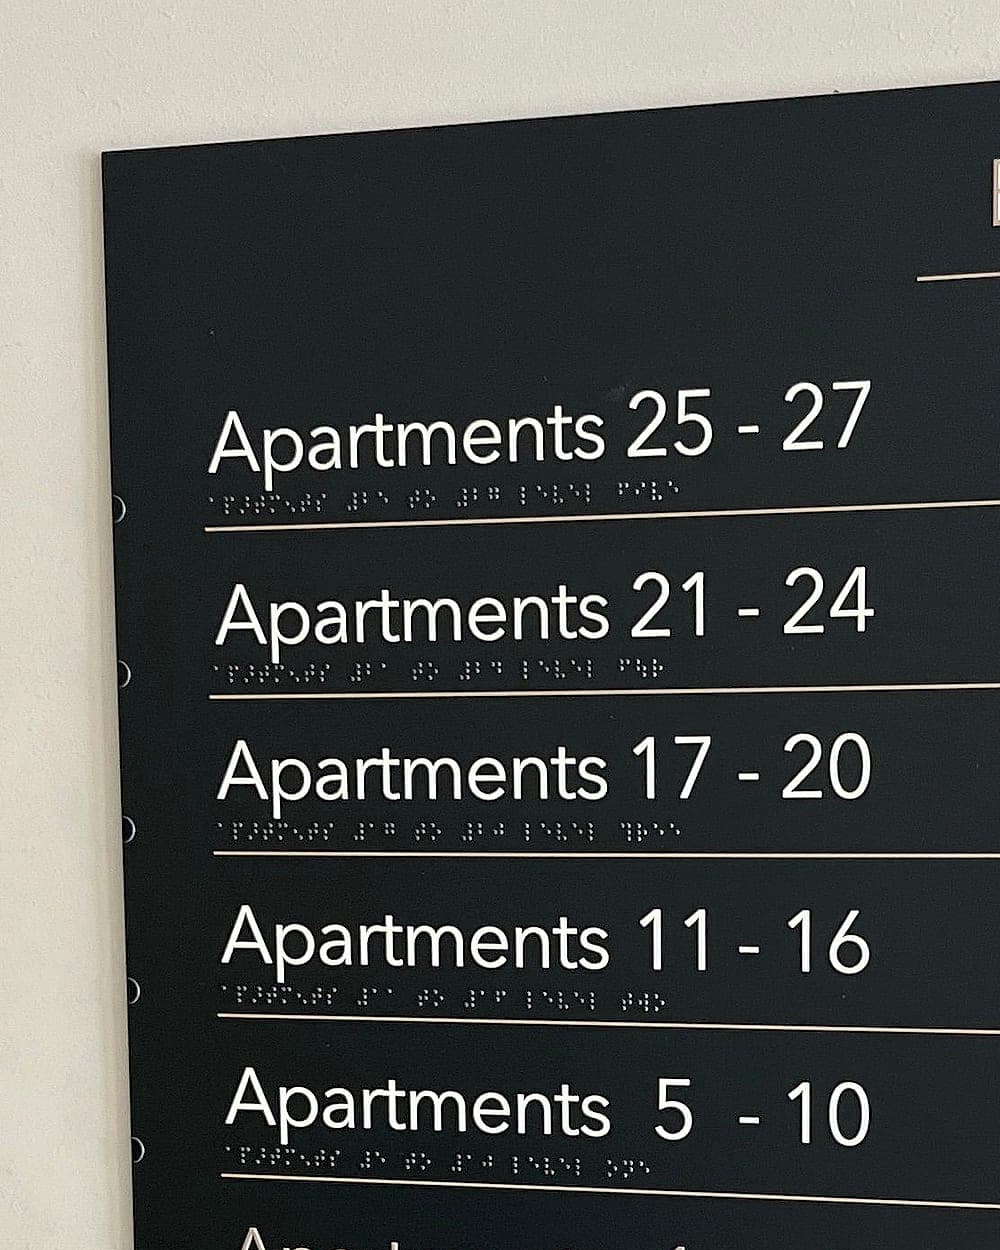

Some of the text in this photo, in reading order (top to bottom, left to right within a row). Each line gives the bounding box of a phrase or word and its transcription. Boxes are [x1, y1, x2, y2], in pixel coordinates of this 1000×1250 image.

[207, 405, 605, 492] Apartments
[627, 388, 713, 458] 25
[737, 424, 760, 434] -
[782, 379, 871, 451] 27
[215, 584, 610, 665] Apartments
[630, 571, 704, 638] 21
[738, 608, 760, 617] -
[783, 566, 875, 634] 24
[216, 739, 608, 820] Apartments
[632, 735, 711, 800] 17
[738, 772, 760, 781] -
[782, 732, 871, 800] 20
[220, 904, 610, 984] Apartments
[639, 908, 706, 971] 11
[738, 945, 760, 954] -
[787, 909, 870, 975] 16
[224, 1066, 611, 1146] Apartments
[654, 1077, 693, 1141] 5
[738, 1116, 760, 1125] -
[787, 1081, 870, 1147] 10
